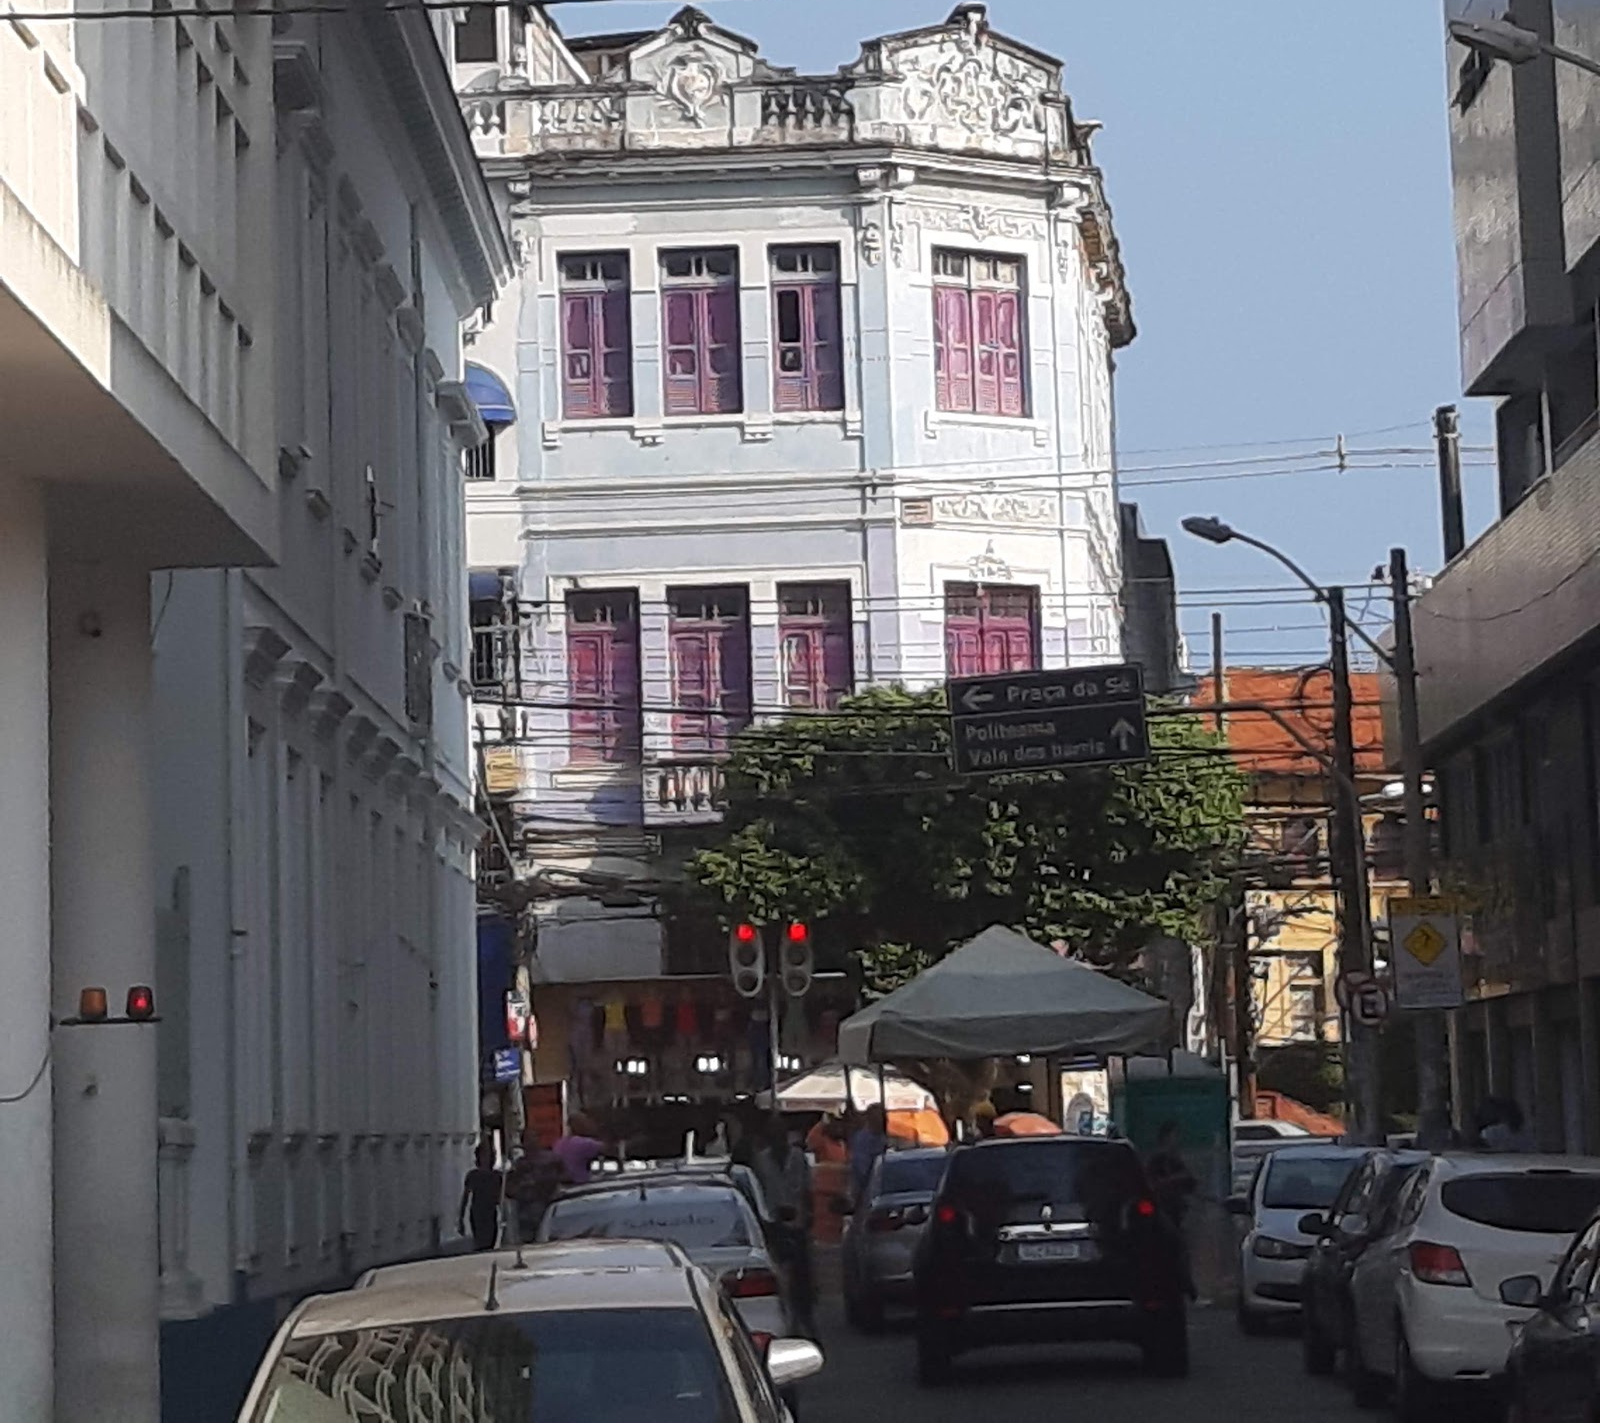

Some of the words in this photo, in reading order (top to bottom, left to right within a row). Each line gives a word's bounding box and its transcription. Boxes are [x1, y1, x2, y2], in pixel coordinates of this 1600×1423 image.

[1006, 684, 1066, 703] Praça
[1072, 678, 1099, 697] da
[965, 721, 1056, 740] Polita
